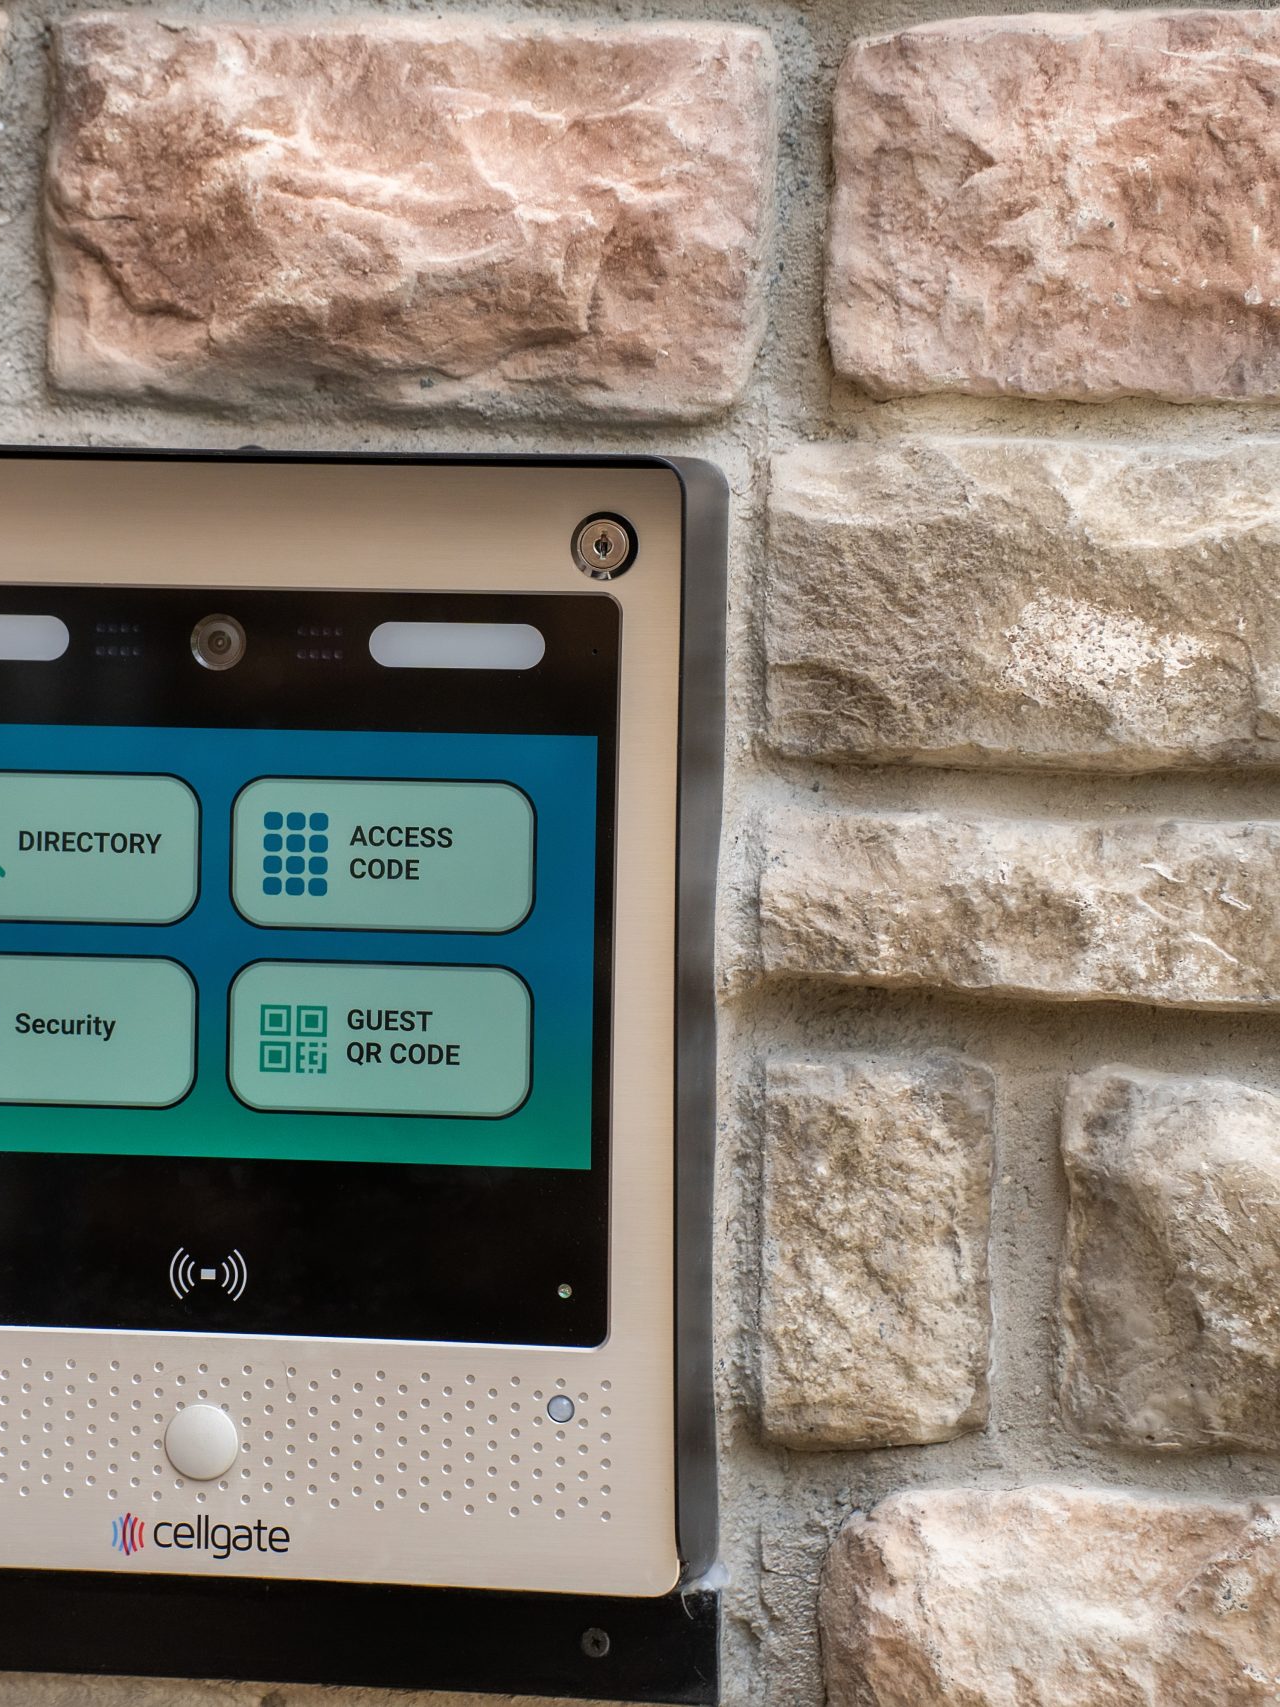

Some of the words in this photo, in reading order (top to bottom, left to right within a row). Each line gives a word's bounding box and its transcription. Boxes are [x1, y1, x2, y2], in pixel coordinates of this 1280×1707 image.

[19, 830, 162, 854] DIRECTORY
[350, 825, 453, 848] ACCESS
[349, 858, 420, 880] CODE
[15, 1012, 116, 1041] Security
[347, 1009, 433, 1032] GUEST
[346, 1041, 382, 1066] QR
[390, 1043, 460, 1066] CODE
[153, 1514, 290, 1559] cellgate
